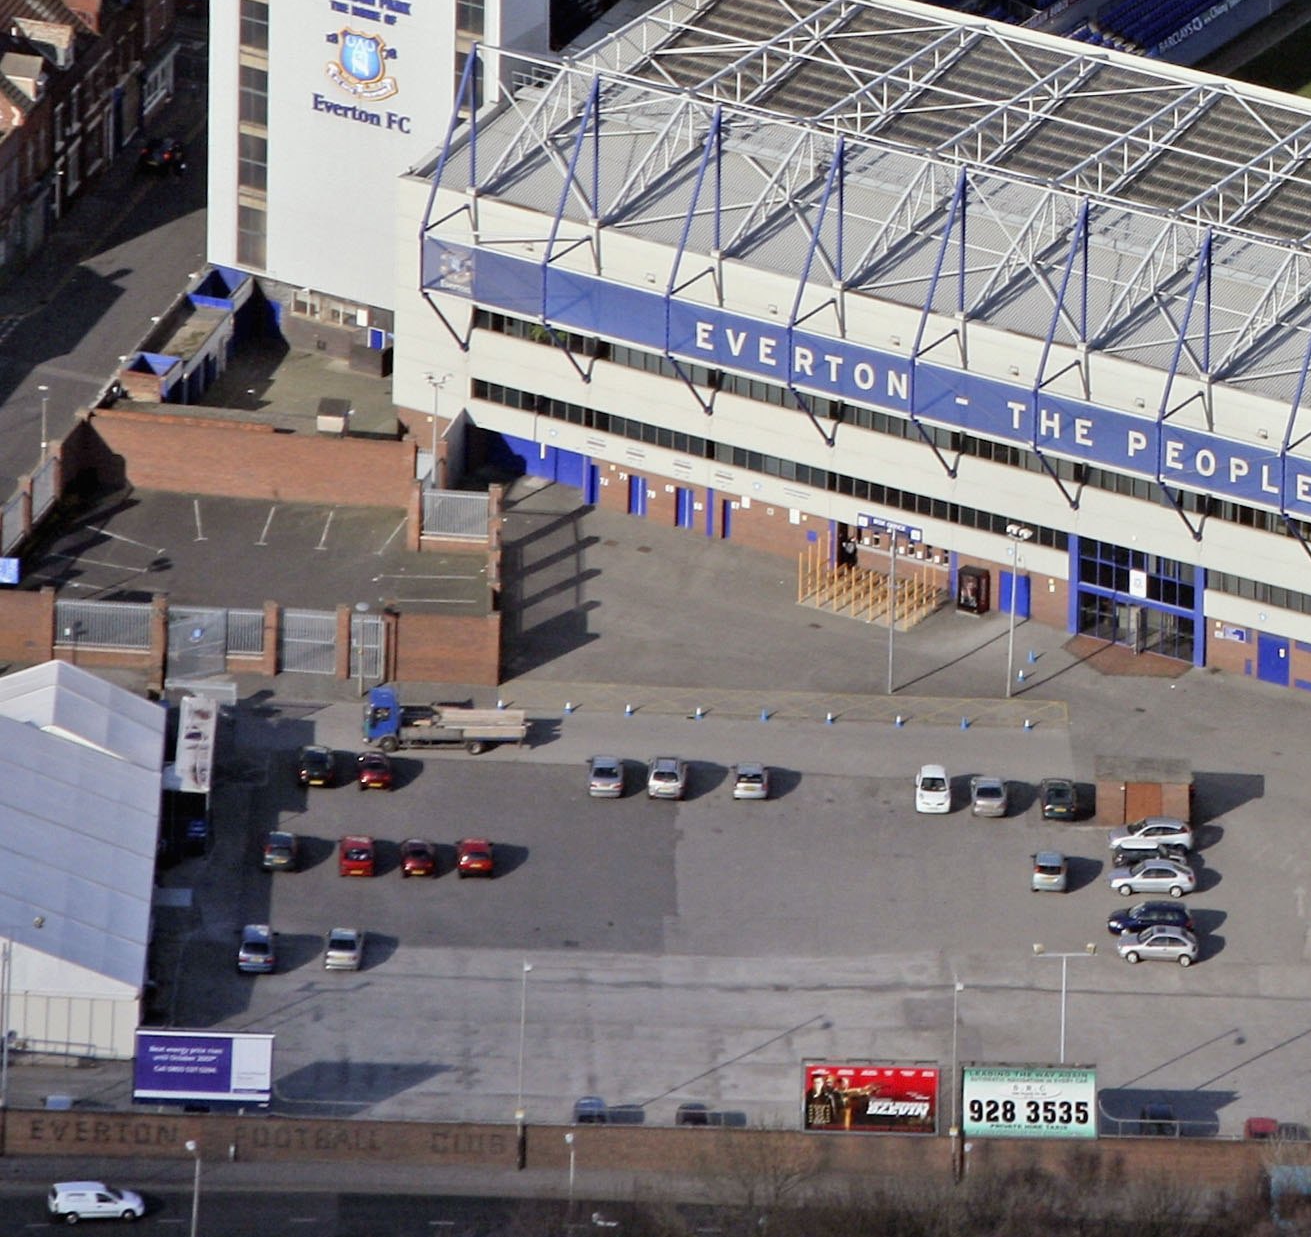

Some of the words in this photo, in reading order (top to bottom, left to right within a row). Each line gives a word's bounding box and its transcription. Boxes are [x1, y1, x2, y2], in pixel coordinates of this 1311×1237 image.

[312, 92, 382, 127] Everton
[385, 111, 411, 134] FC
[695, 321, 909, 401] EVERTON
[1007, 401, 1094, 448] THE
[969, 1099, 1016, 1123] 928
[1026, 1100, 1089, 1124] 3535
[29, 1120, 178, 1145] EVERTON
[233, 1124, 382, 1153] FOOTBALL
